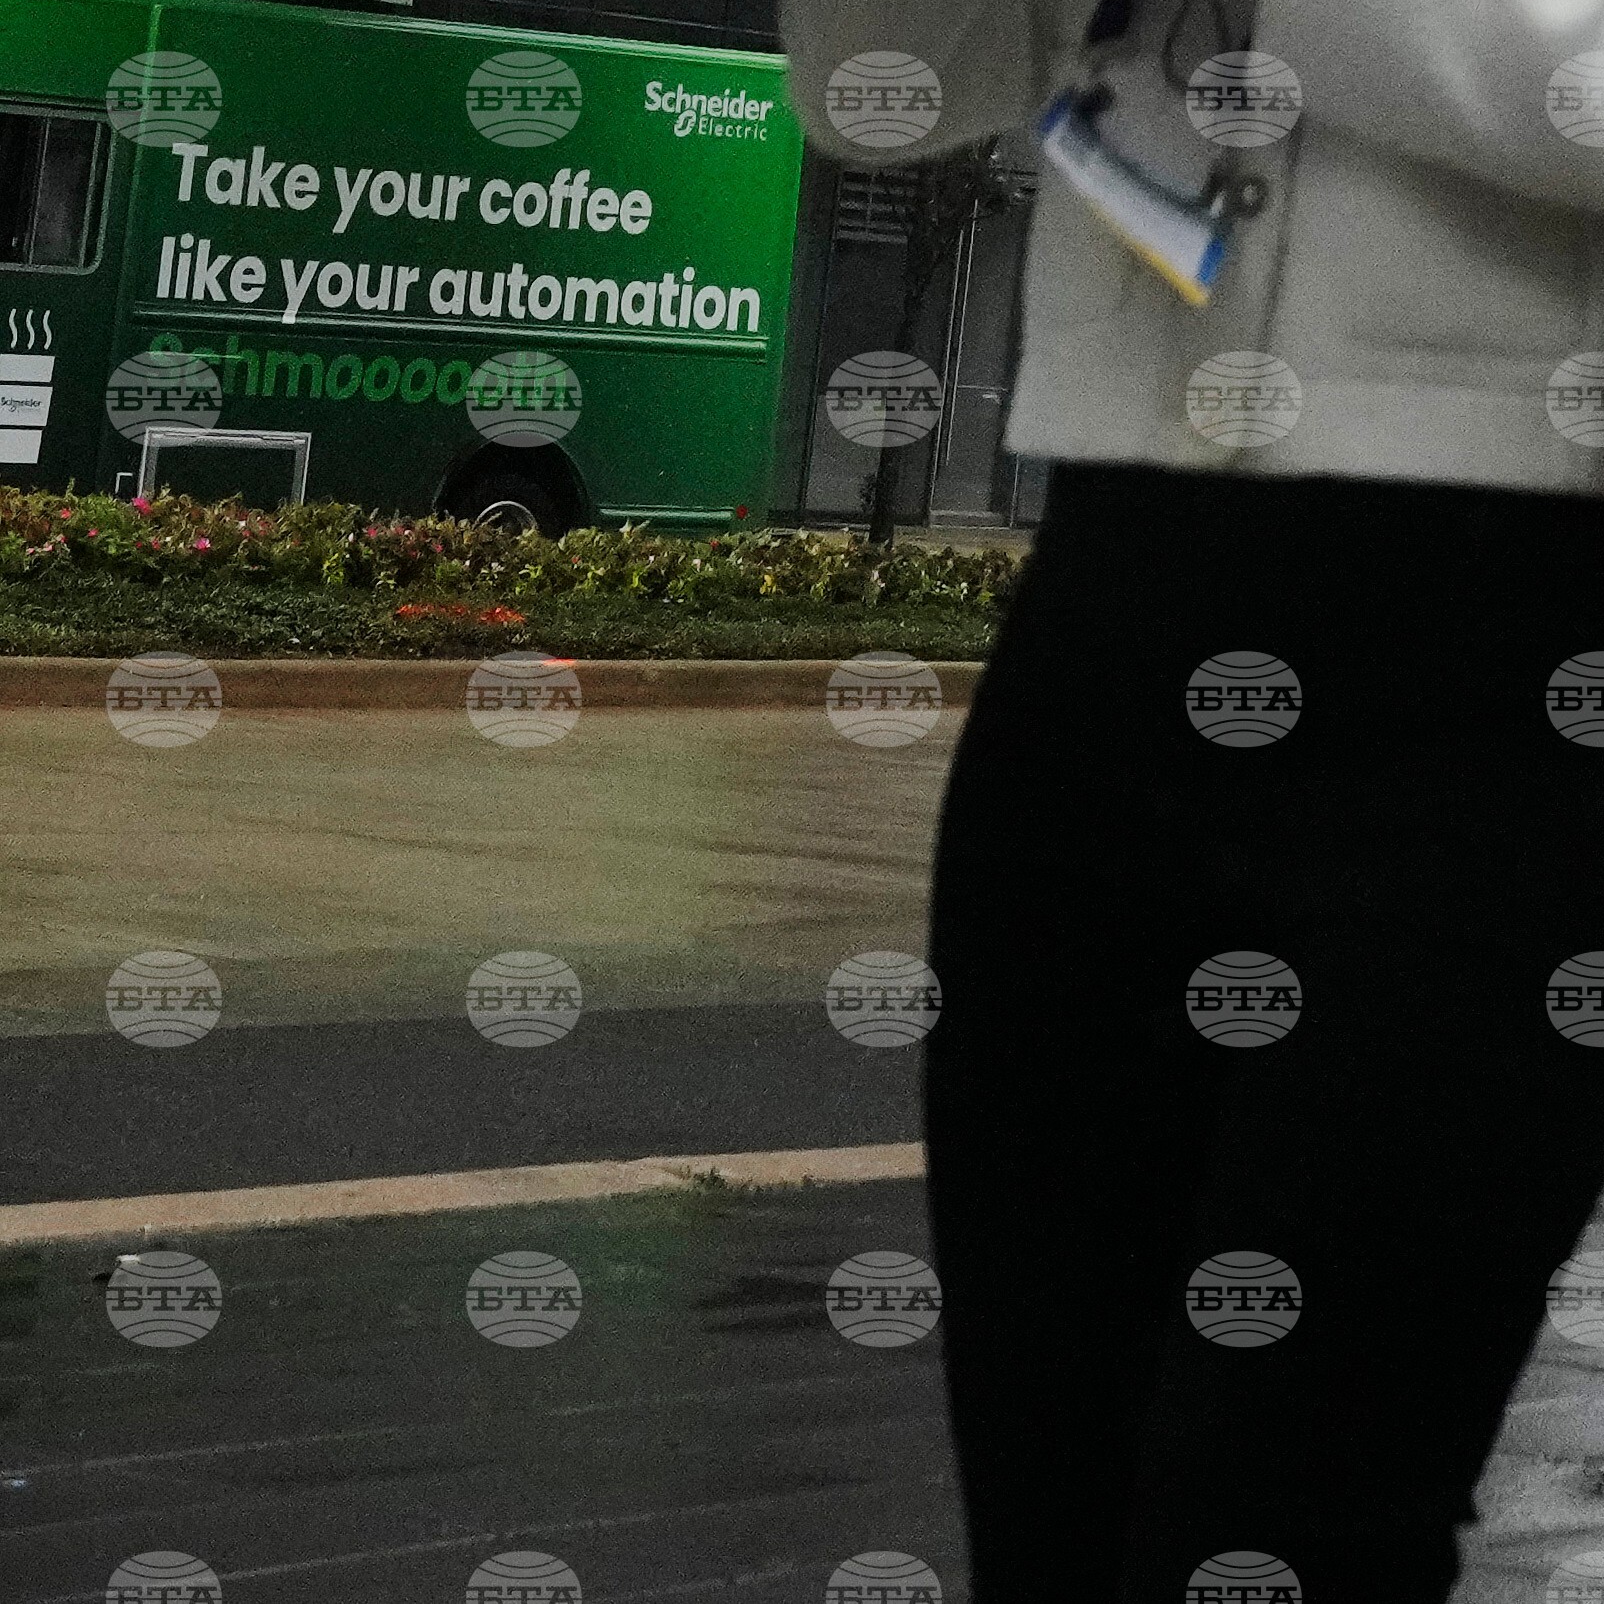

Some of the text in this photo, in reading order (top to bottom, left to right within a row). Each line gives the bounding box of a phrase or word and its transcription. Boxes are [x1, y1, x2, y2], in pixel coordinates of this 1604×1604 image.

[644, 80, 774, 121] Schneider
[698, 116, 768, 141] Electric
[171, 142, 653, 235] Take your coffee
[155, 232, 760, 332] like your automation
